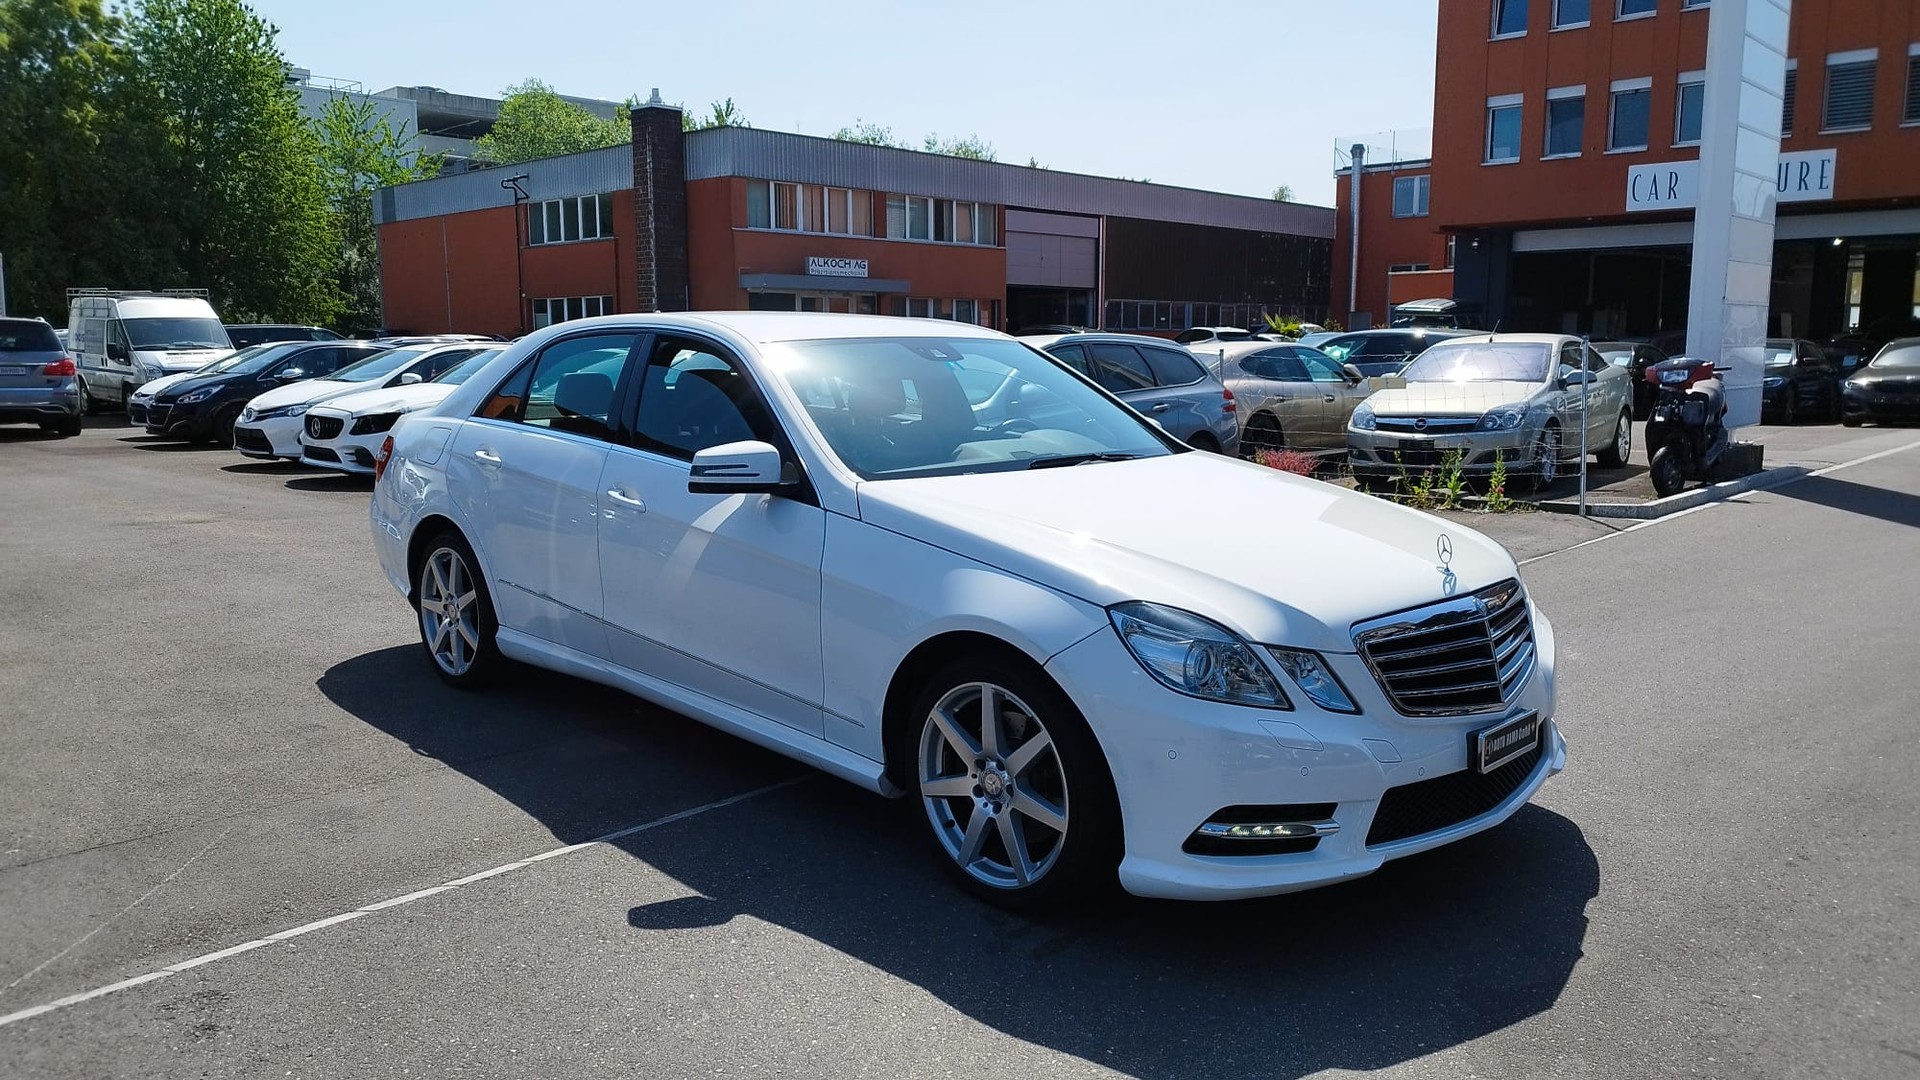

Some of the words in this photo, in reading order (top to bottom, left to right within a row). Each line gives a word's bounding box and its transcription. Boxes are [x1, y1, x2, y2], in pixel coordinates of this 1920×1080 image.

[1632, 171, 1679, 202] CAR
[811, 258, 851, 269] ALKOCH
[854, 260, 866, 270] AG
